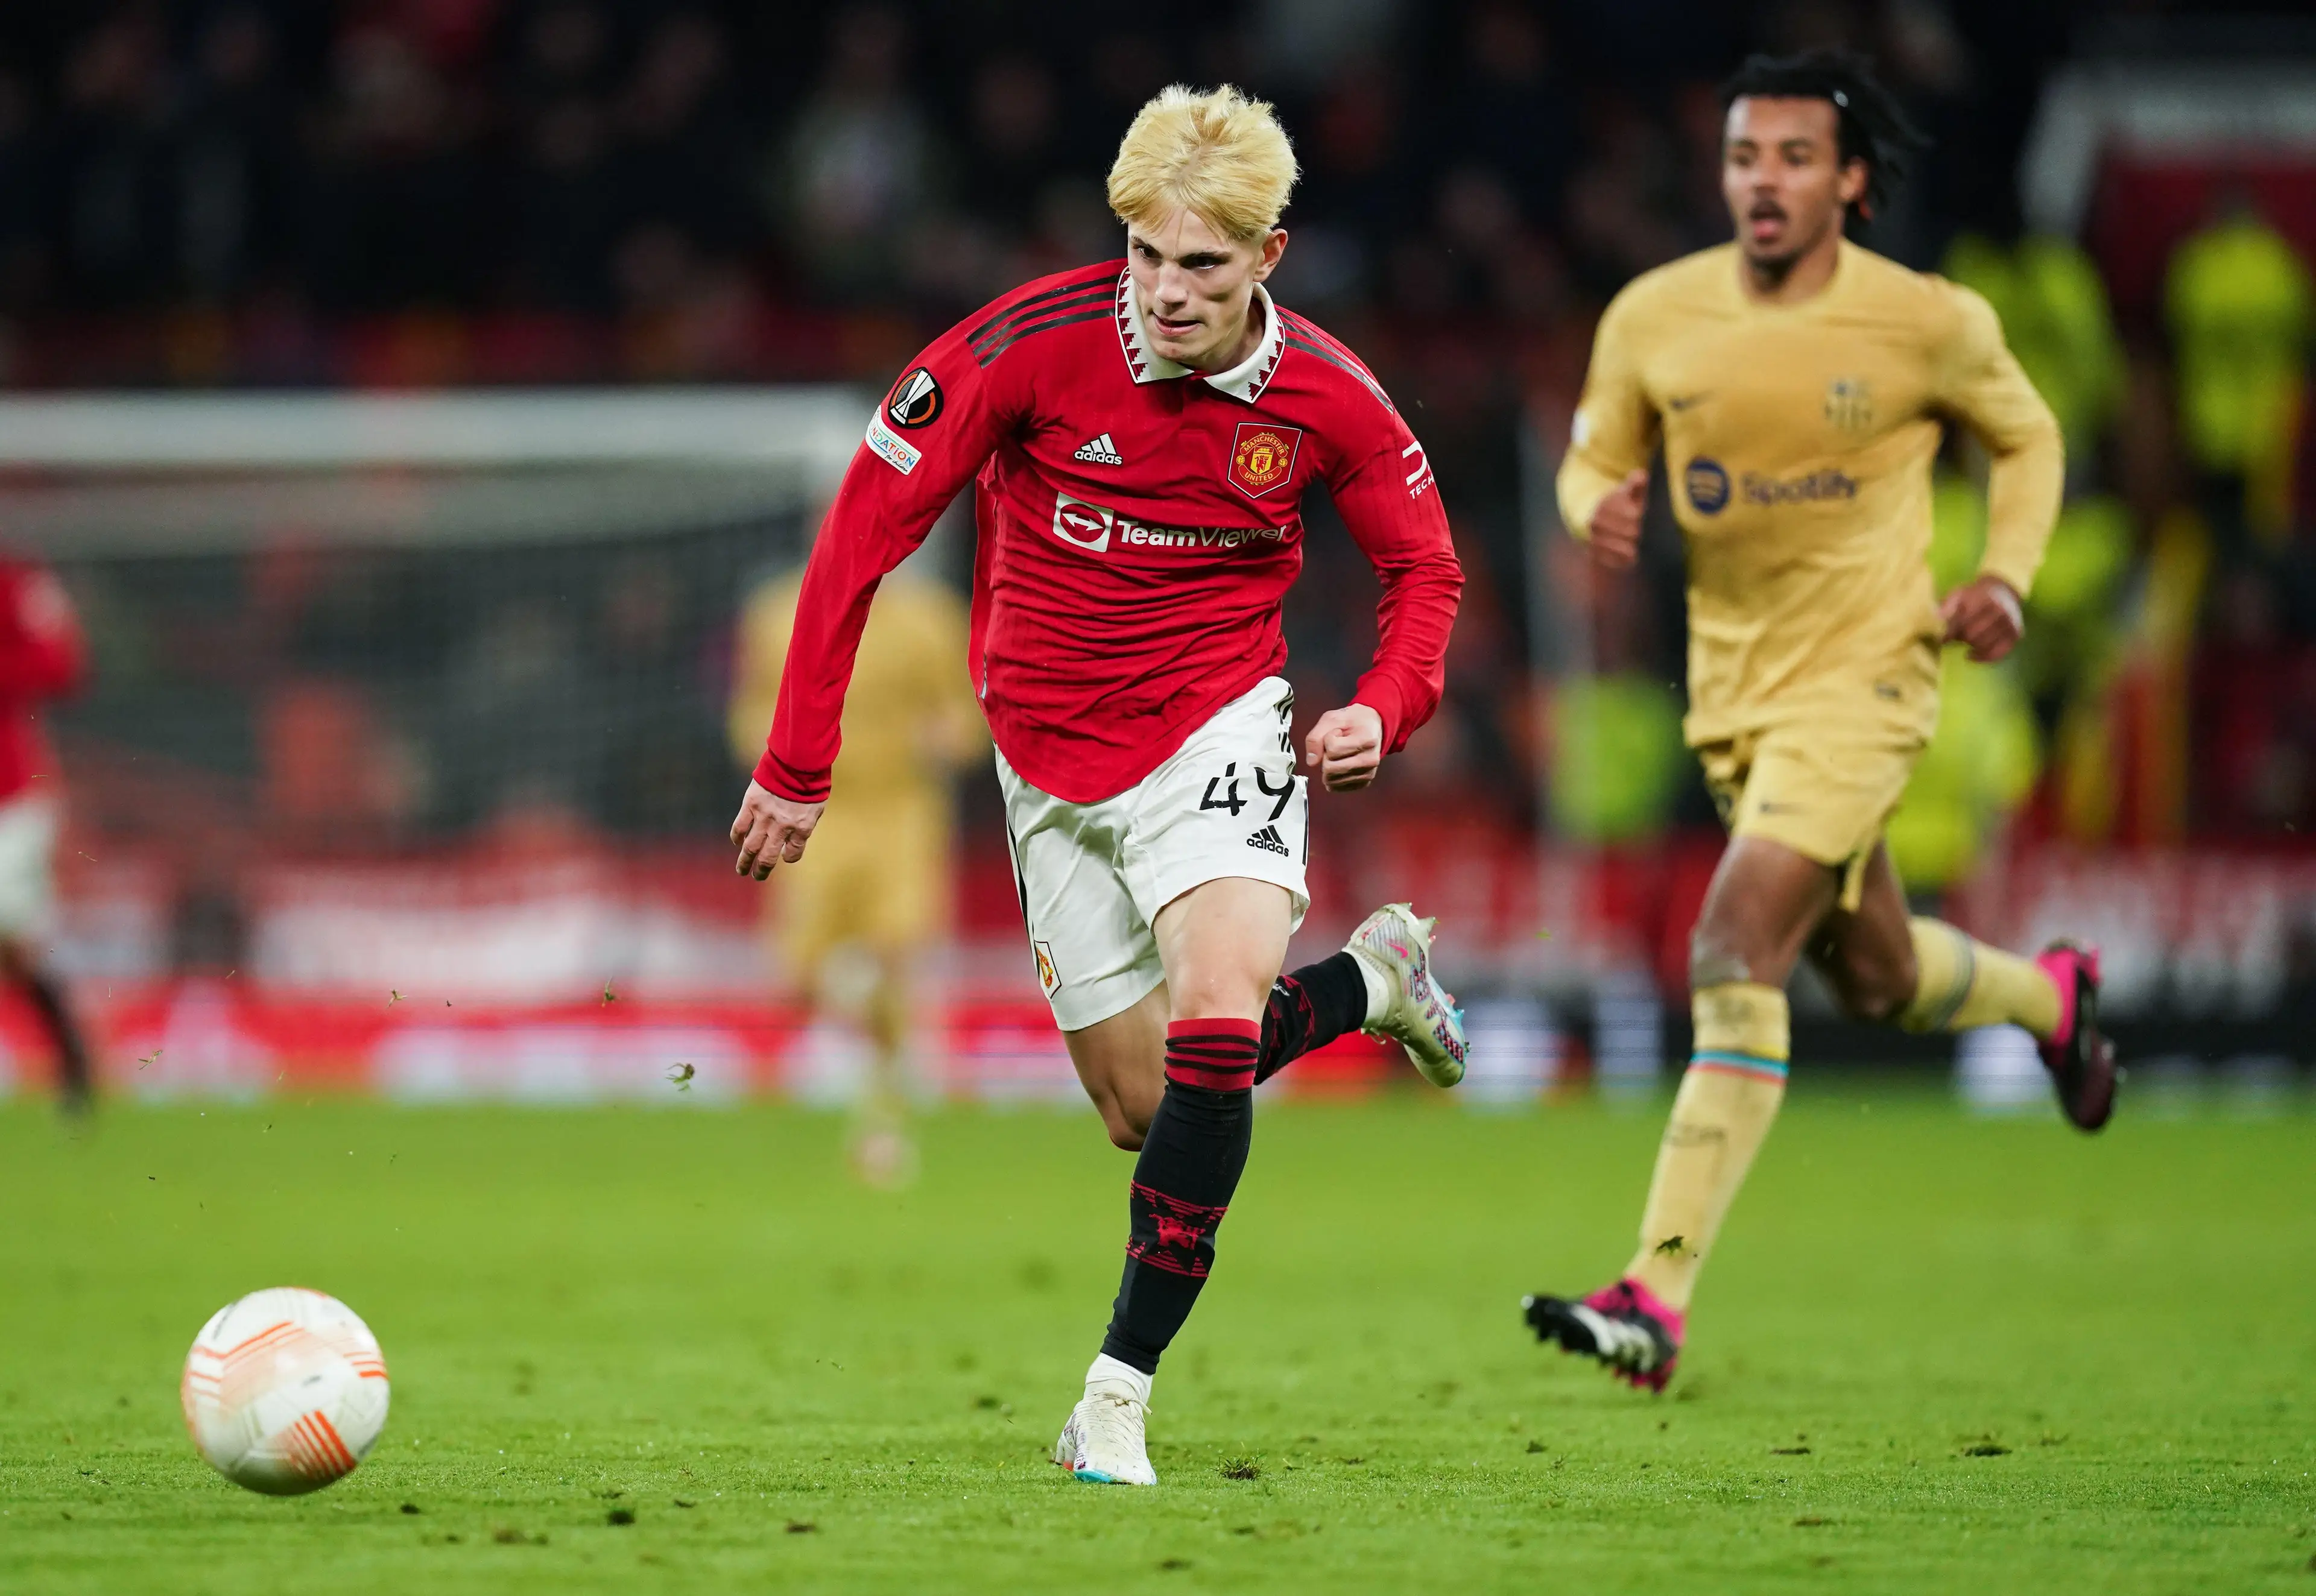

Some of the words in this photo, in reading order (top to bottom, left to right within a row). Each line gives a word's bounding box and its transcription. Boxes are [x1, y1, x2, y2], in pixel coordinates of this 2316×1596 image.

[1244, 436, 1285, 455] MANCHESTER
[1074, 450, 1122, 465] adidas
[1245, 472, 1273, 482] UNITED
[1117, 520, 1287, 547] TeamViewer
[1199, 762, 1296, 822] 49
[1246, 838, 1289, 857] adidas
